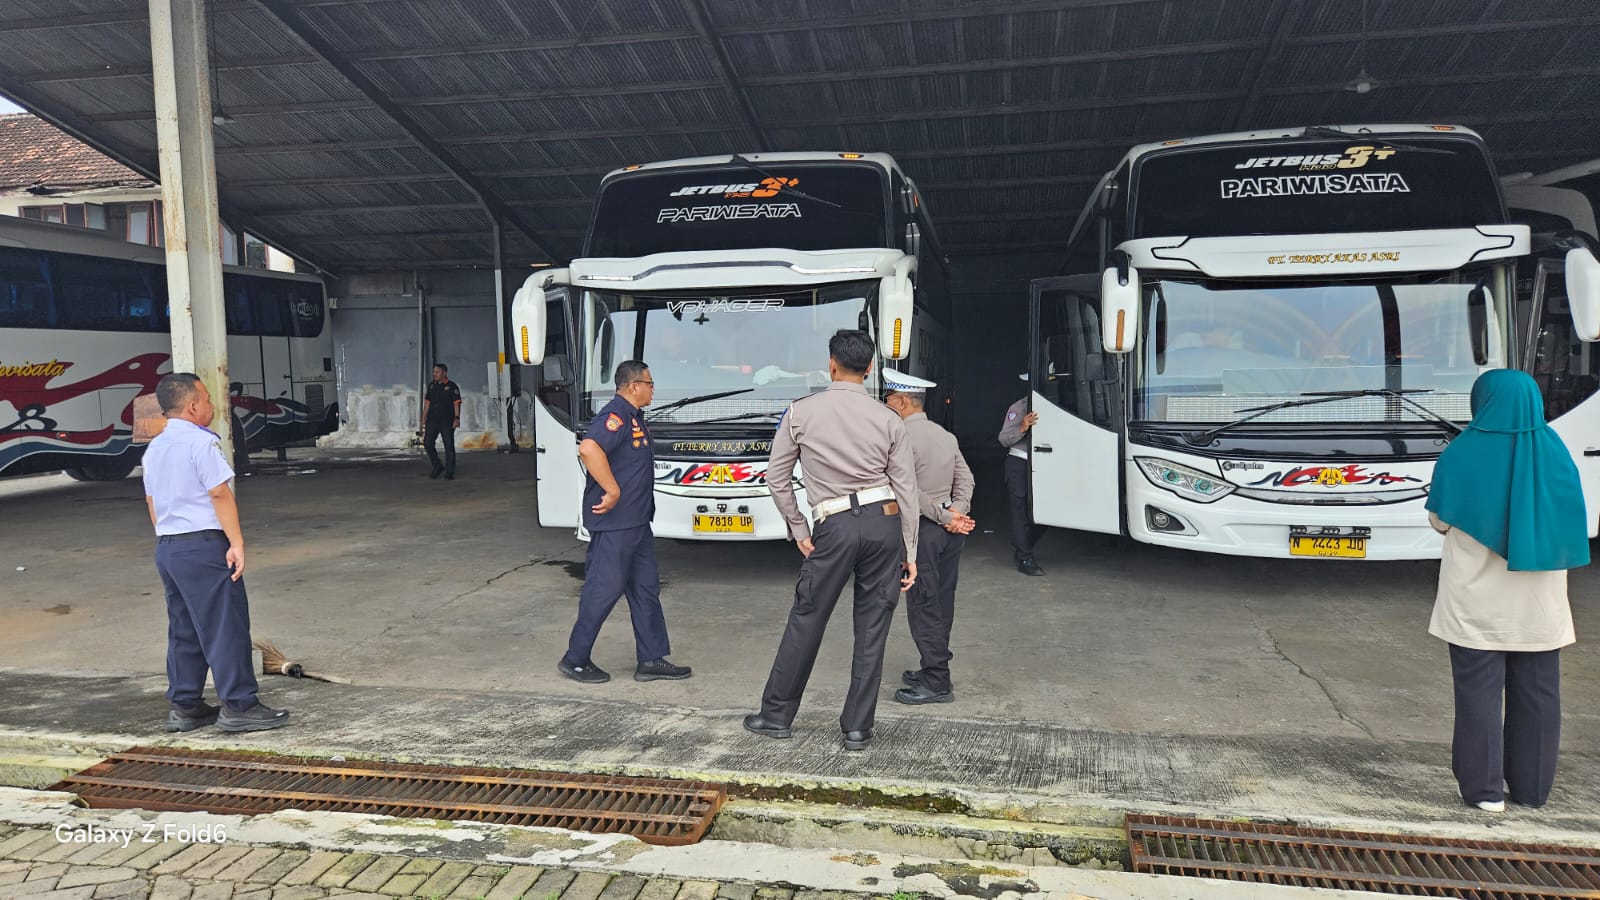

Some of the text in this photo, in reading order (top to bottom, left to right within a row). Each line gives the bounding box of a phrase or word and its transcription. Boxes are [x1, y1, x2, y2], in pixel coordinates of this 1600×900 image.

[1235, 154, 1342, 170] JETBUS
[670, 183, 759, 197] JETBUS
[1221, 173, 1411, 199] PARIWISATA
[657, 203, 802, 223] PARIWISATA
[686, 441, 719, 452] TERRY
[719, 441, 747, 452] AKAS
[694, 516, 752, 527] N 7818 UP
[1293, 537, 1300, 549] N
